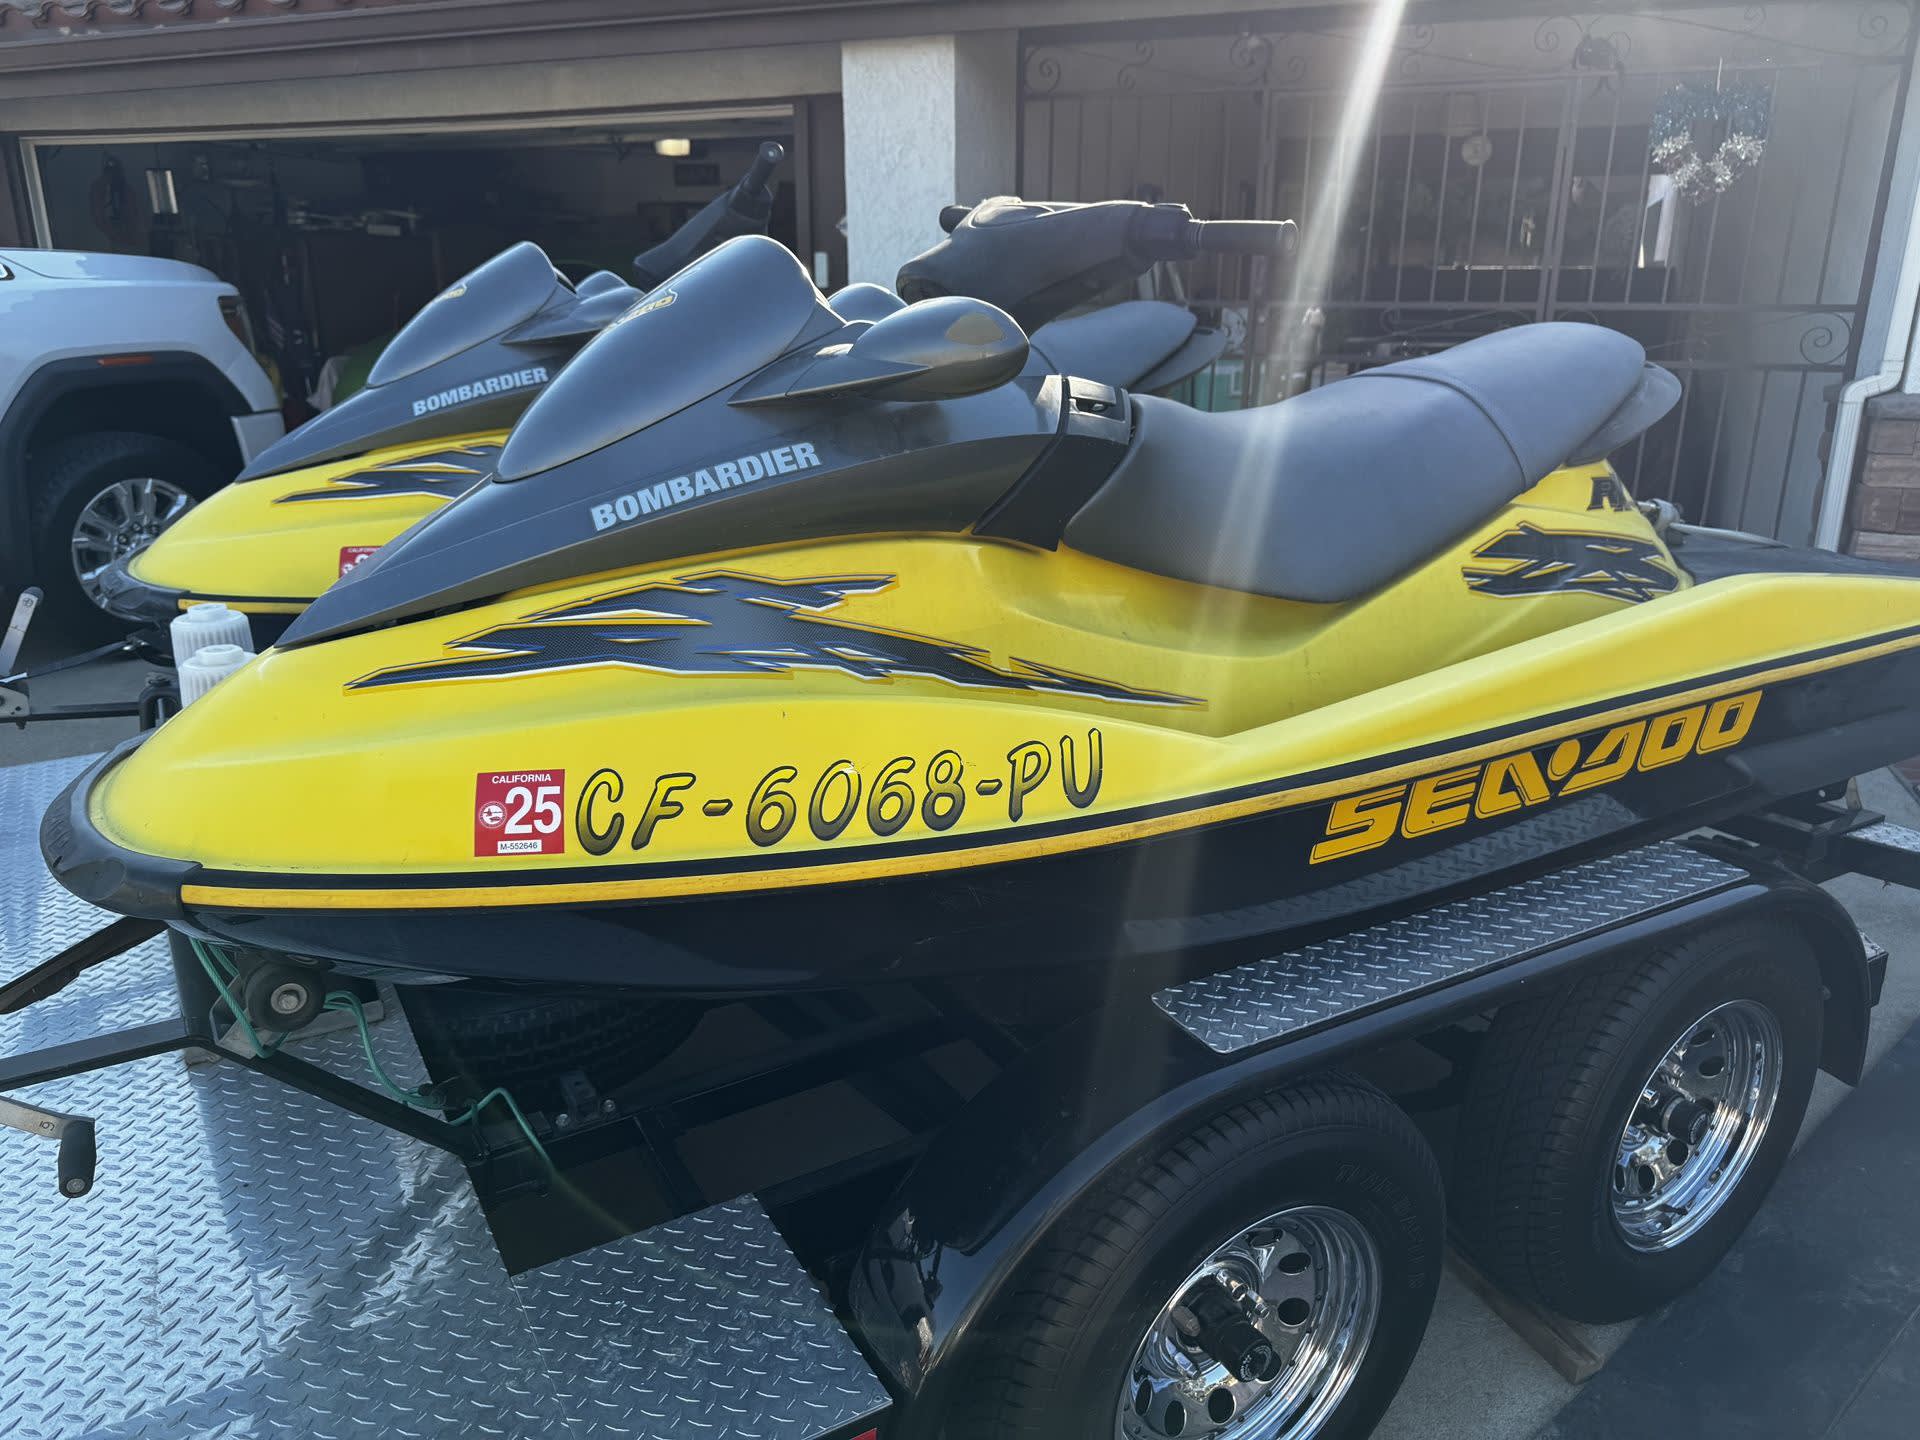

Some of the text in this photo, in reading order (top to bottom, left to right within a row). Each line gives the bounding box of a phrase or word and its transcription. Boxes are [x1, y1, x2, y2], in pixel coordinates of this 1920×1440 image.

[412, 367, 549, 416] BOMBARDIER
[591, 442, 821, 532] BOMBARDIER
[492, 774, 551, 783] CALIFORNIA
[577, 728, 1103, 856] CF-6068-PU
[504, 786, 562, 833] 25
